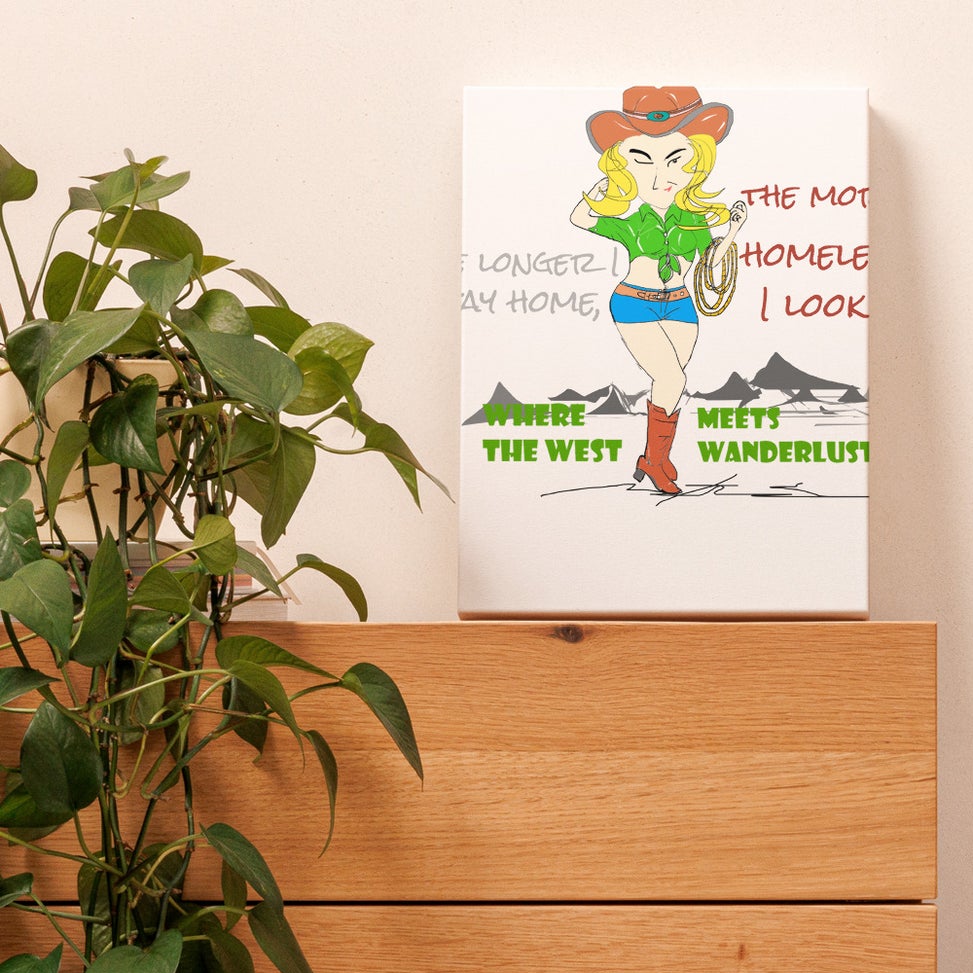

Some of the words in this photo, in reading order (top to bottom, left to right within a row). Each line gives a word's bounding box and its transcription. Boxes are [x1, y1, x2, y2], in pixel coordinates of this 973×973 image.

[741, 184, 800, 210] THE
[479, 252, 606, 277] LONGER
[611, 247, 619, 276] I
[739, 241, 869, 271] HOMELE
[505, 289, 600, 321] HOME,
[760, 286, 769, 321] I
[785, 294, 869, 318] LOOK
[482, 403, 586, 427] WHERE
[697, 406, 780, 430] MEETS
[482, 438, 538, 462] THE
[544, 438, 623, 462] WEST
[697, 440, 870, 463] WANDERLUST
